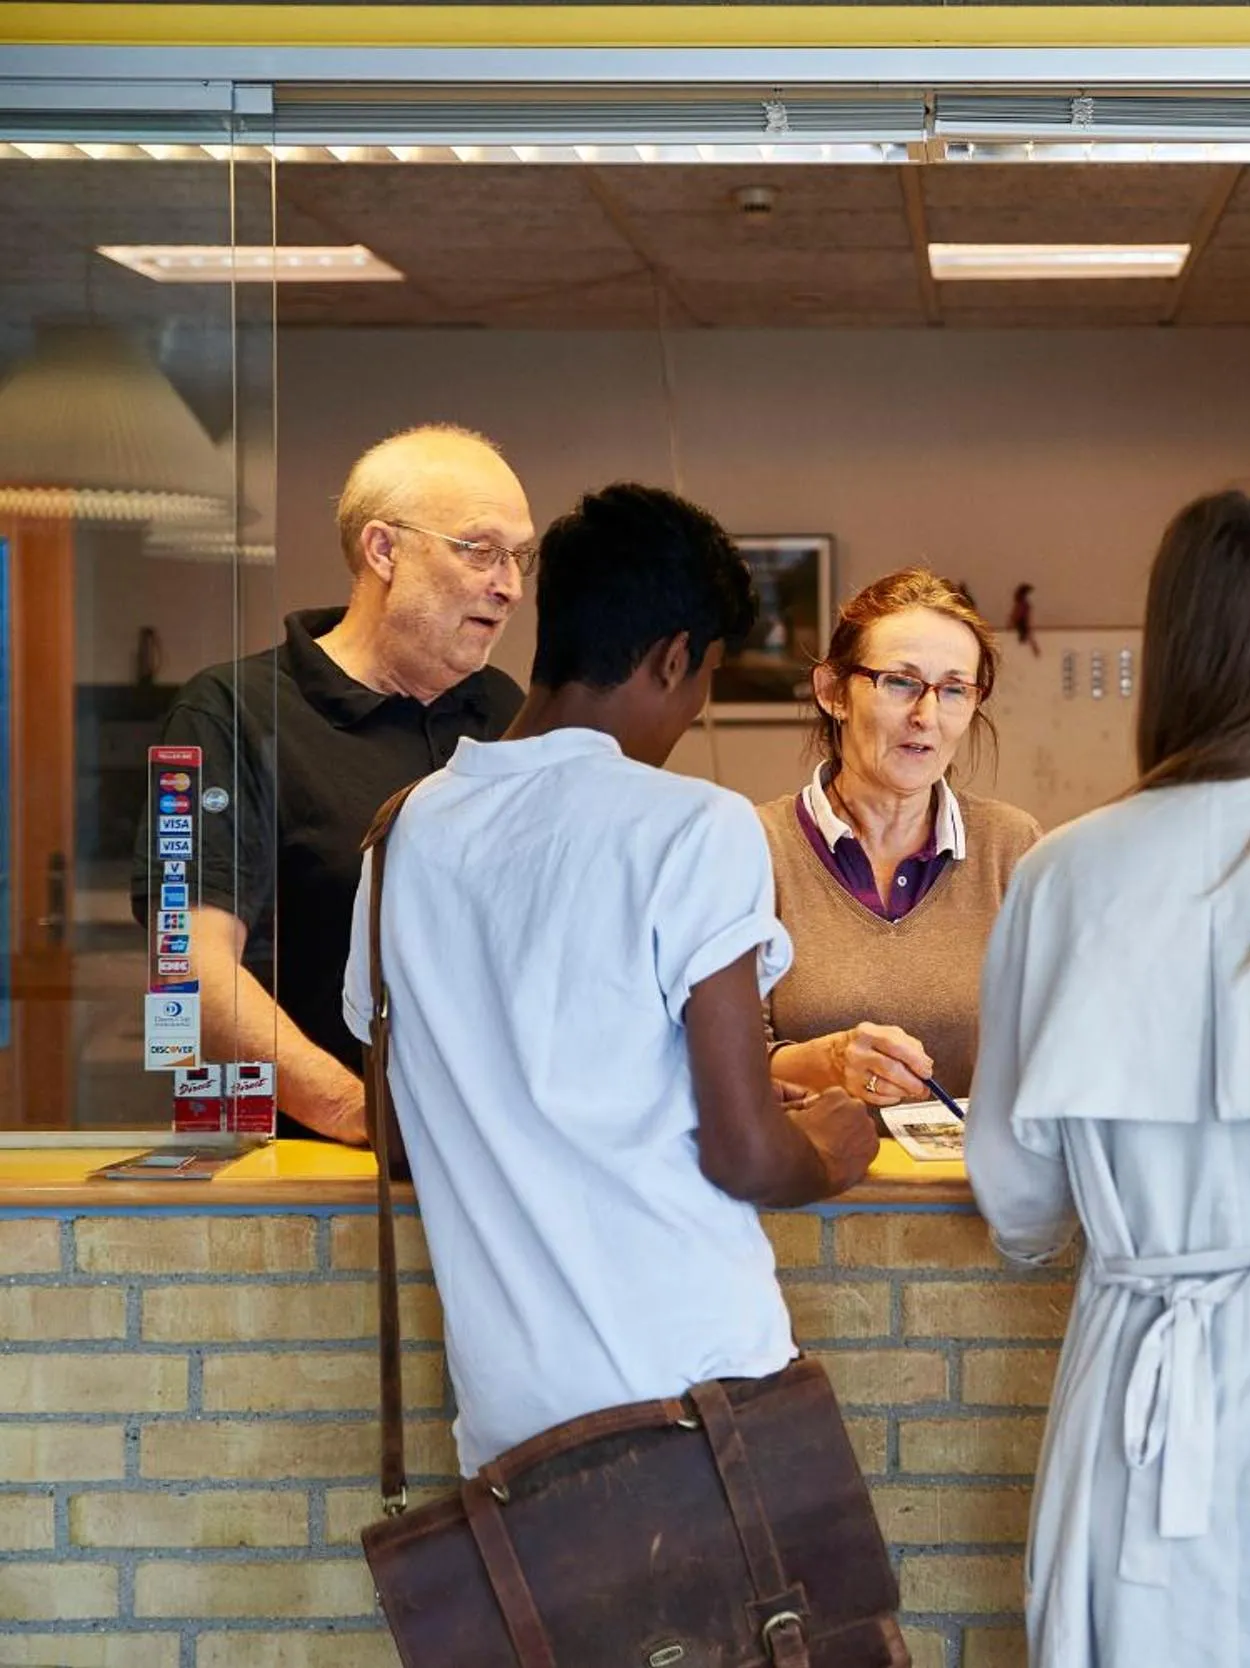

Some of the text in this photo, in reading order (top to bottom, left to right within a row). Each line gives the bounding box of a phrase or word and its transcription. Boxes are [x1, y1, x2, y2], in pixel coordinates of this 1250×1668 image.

[163, 819, 189, 829] VISA
[163, 841, 189, 851] VISA
[151, 1045, 193, 1054] DISCOVER
